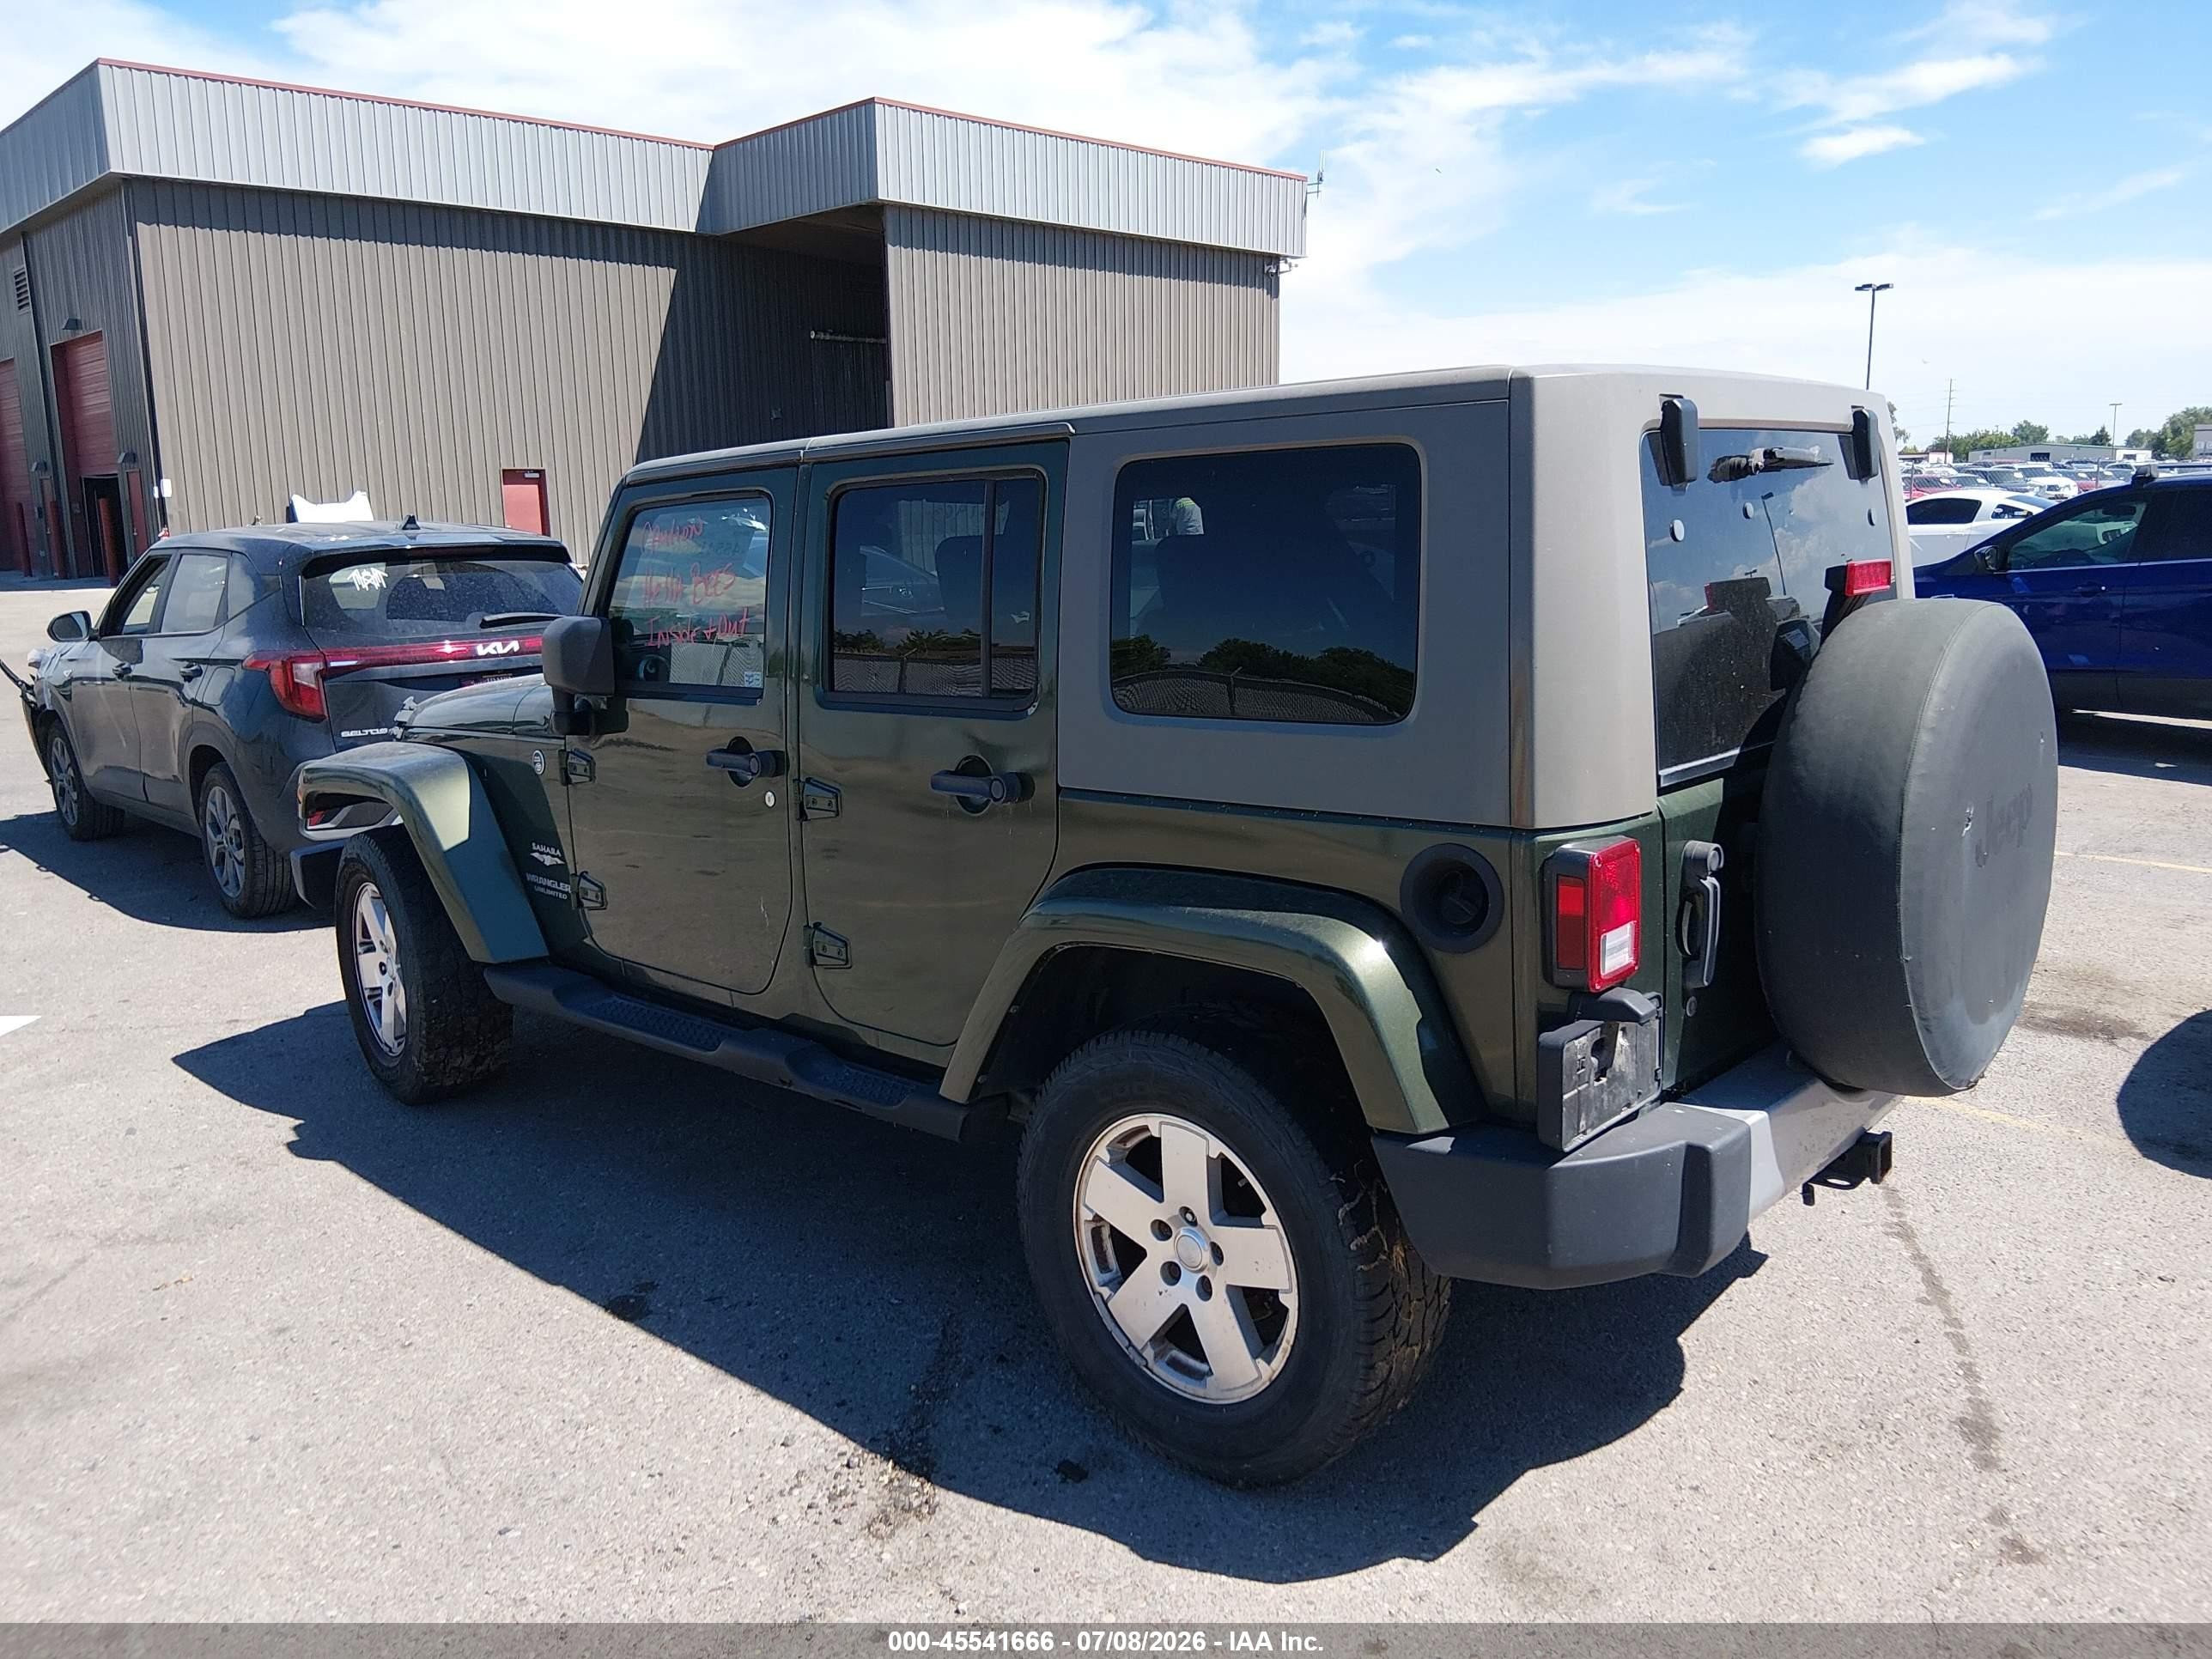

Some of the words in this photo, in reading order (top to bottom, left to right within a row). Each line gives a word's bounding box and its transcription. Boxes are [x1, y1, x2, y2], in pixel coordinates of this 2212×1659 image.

[645, 614, 702, 649] Inside
[718, 606, 750, 637] Out
[477, 640, 520, 656] KIA
[341, 727, 388, 738] SELTOS
[532, 842, 562, 857] SAHARA
[526, 872, 572, 894] WRANGLER
[534, 885, 568, 900] UNLIMITED
